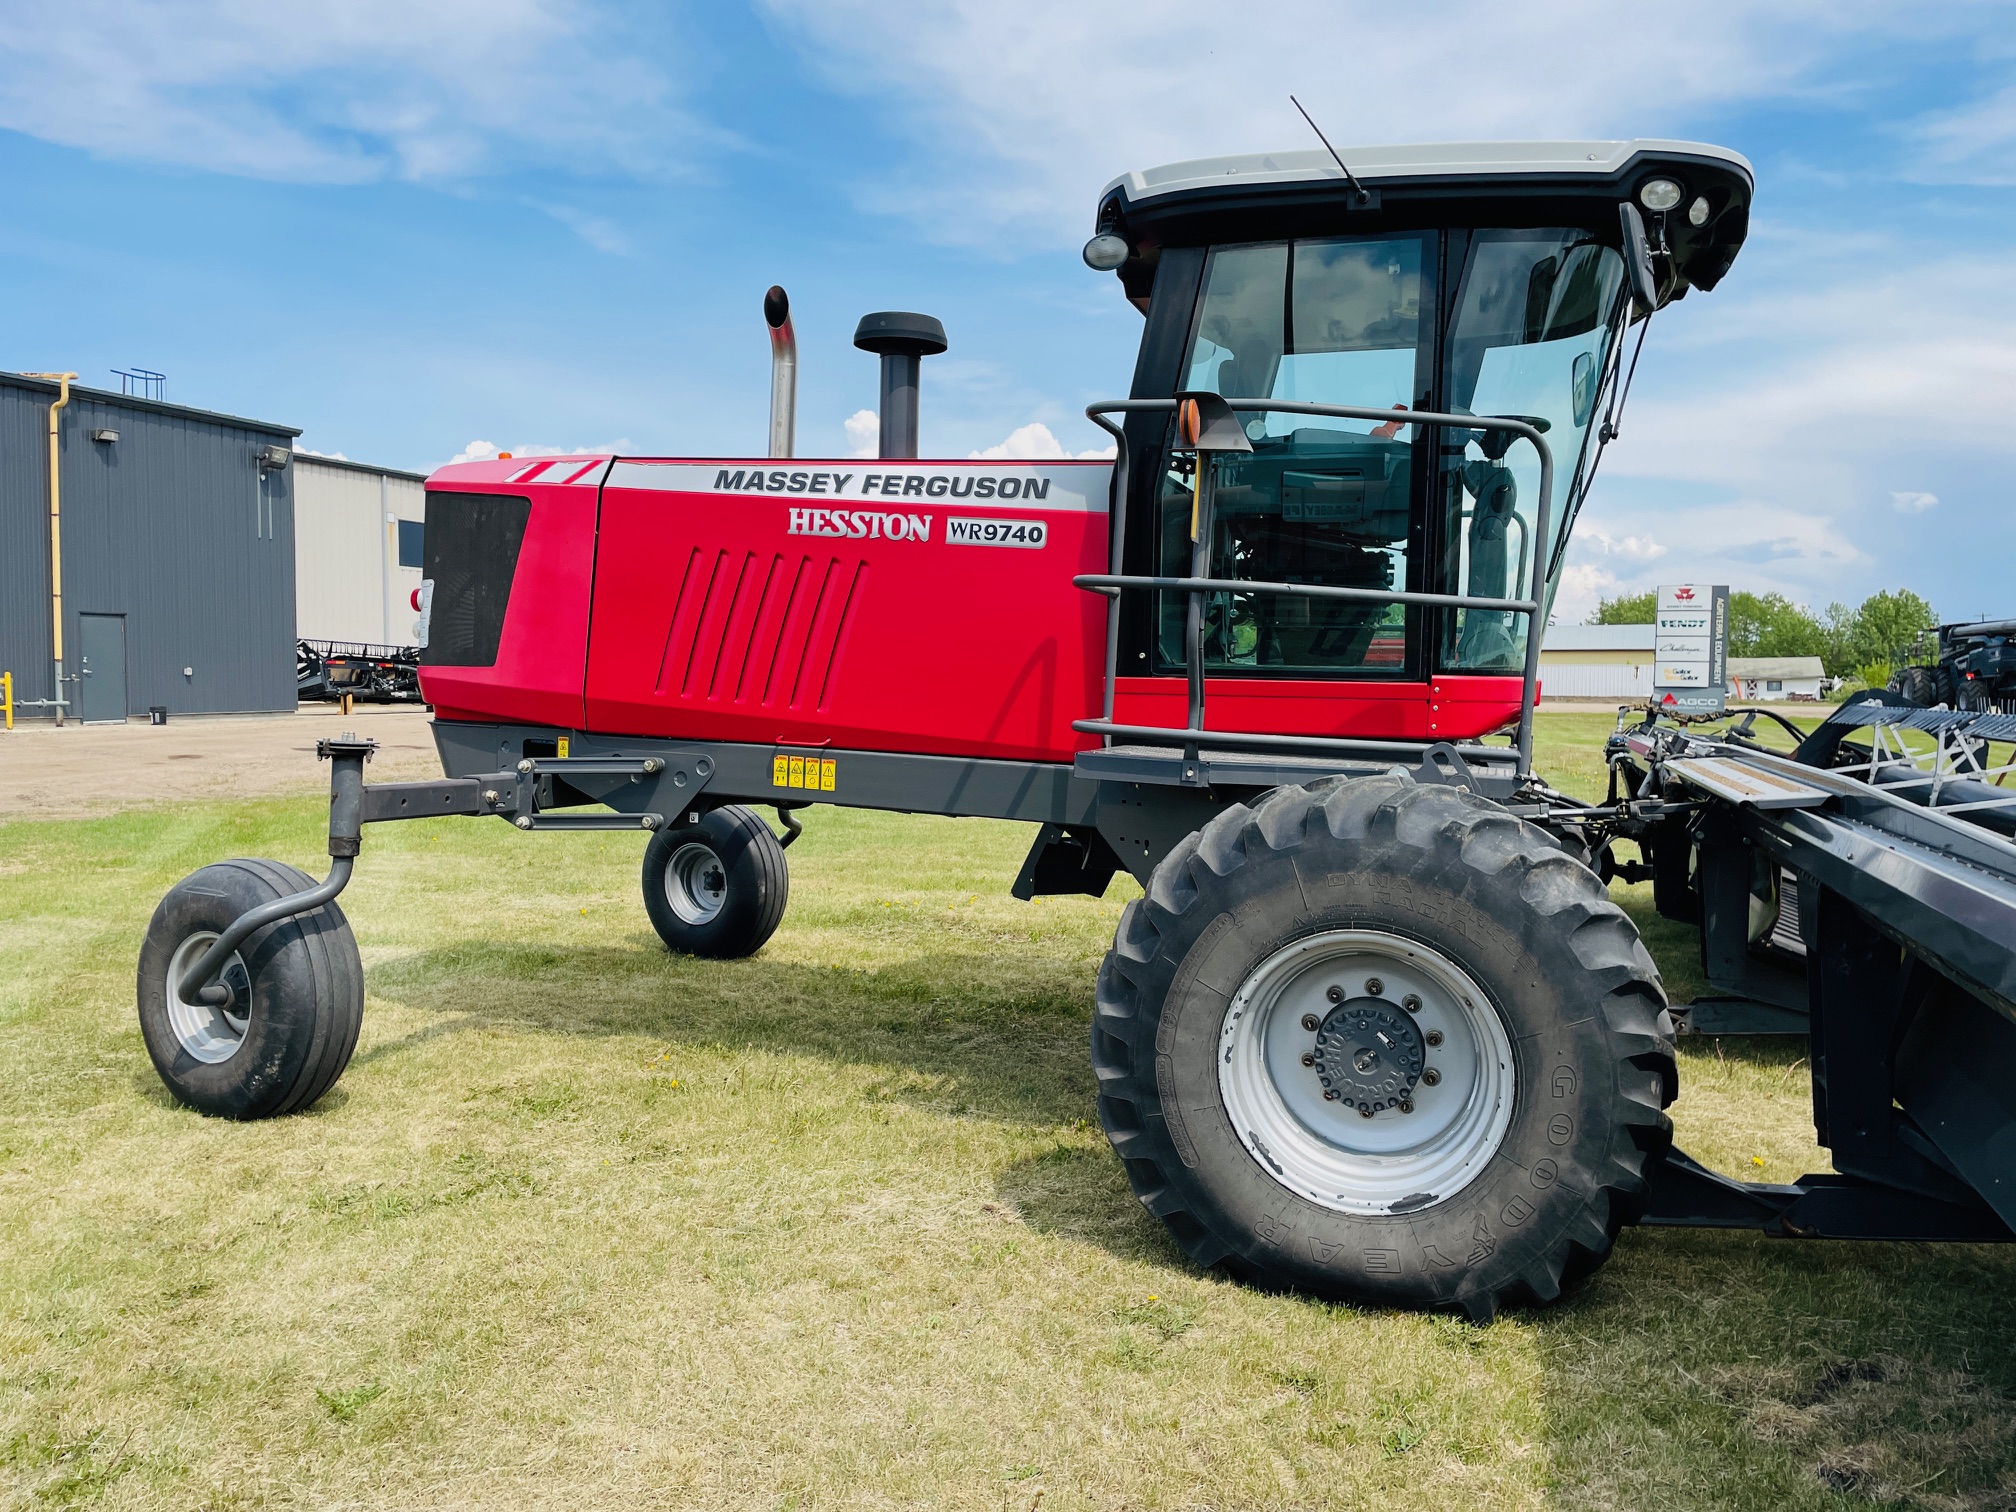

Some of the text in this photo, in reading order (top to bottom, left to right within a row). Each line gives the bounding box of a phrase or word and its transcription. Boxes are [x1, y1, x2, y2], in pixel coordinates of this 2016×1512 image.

[713, 469, 1050, 499] MASSEY FERGUSON
[787, 507, 933, 542] HESSTON
[950, 521, 1044, 543] WR9740
[1660, 620, 1707, 628] FENDT
[1713, 597, 1725, 685] AGRITERRA EQUIPMENT
[1678, 698, 1719, 706] AGCO
[1327, 873, 1413, 894] DYNA
[1373, 891, 1485, 950] RADIAL
[1254, 1065, 1578, 1274] GOODYEAR
